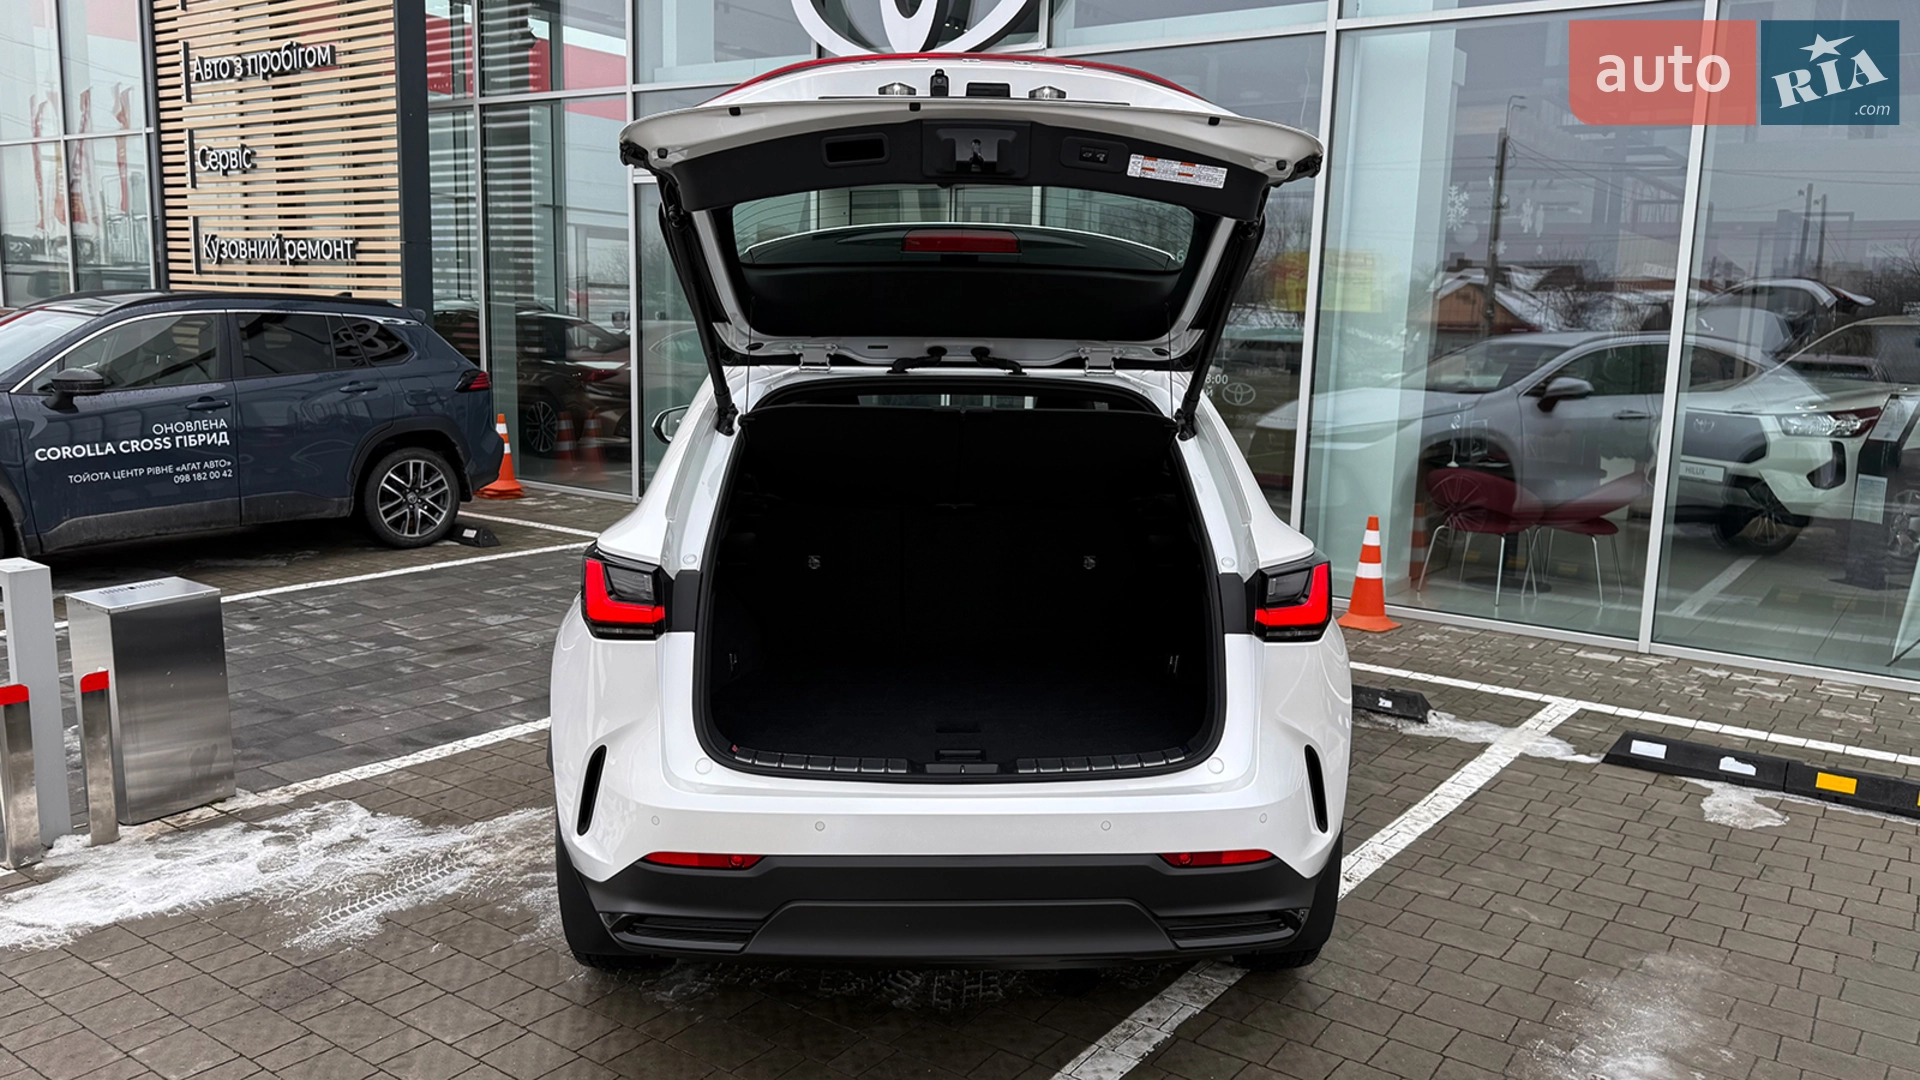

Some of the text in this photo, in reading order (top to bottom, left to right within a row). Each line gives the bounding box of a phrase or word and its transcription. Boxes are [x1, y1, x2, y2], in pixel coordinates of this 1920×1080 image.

[193, 41, 333, 82] Авто з пробігом
[198, 143, 253, 176] Сервіс
[202, 233, 354, 266] Кузовний ремонт
[152, 418, 228, 435] ОНОВЛЕНА
[34, 431, 230, 461] COROLLA CROSS ГІБРИД
[68, 458, 232, 484] ТОЙОТА ЦЕНТР РІВНЕ «АГАТ АВТО»
[173, 468, 233, 484] 098 182 00 42
[1685, 466, 1706, 476] HILUX
